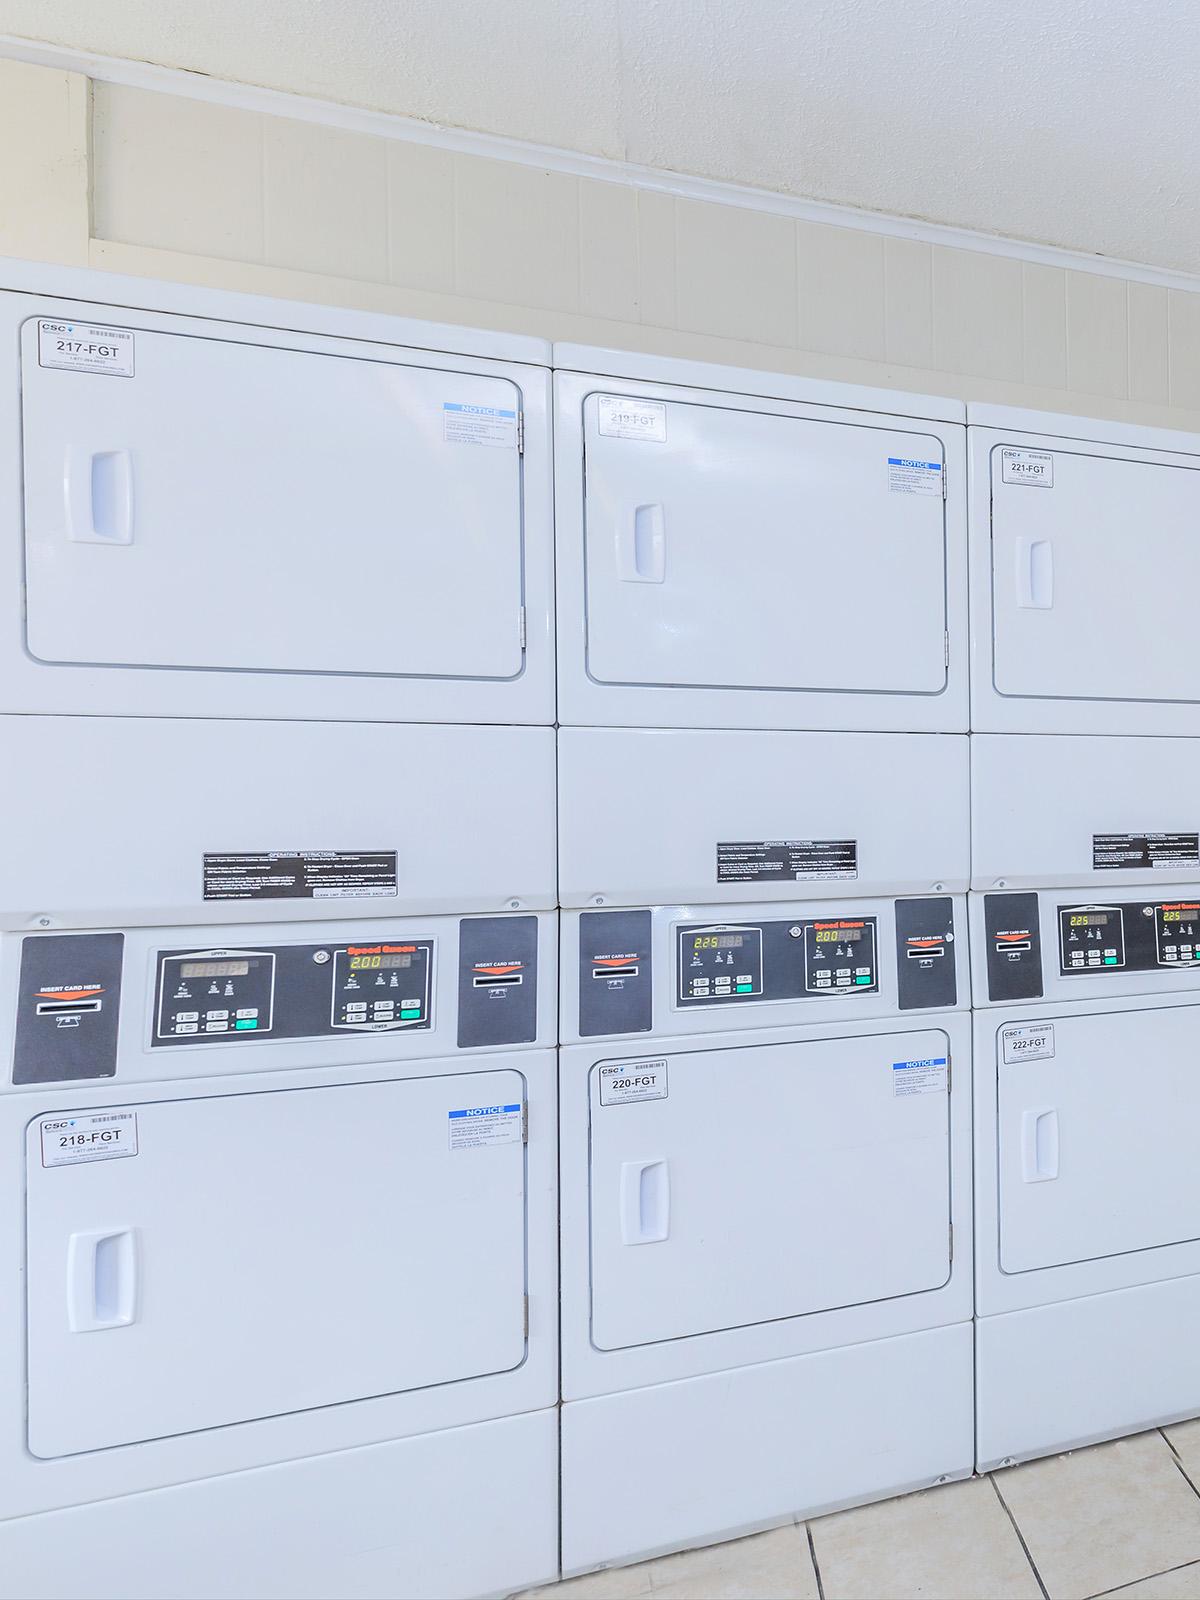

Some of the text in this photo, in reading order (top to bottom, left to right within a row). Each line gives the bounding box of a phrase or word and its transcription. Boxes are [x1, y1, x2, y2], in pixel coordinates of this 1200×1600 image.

[42, 323, 66, 332] CSC
[57, 340, 119, 357] 217-FGT
[461, 405, 500, 416] NOTICE
[611, 412, 655, 426] 219-FGT
[900, 459, 930, 469] NOTICE
[1011, 463, 1045, 474] 221-FGT
[814, 922, 839, 930] Speed
[347, 945, 417, 956] Speed Queen
[1012, 1038, 1046, 1049] 222-FGT
[905, 1060, 935, 1068] NOTICE
[602, 1067, 619, 1075] CSC
[612, 1075, 656, 1089] 220-FGT
[466, 1106, 505, 1117] NOTICE
[44, 1121, 69, 1130] CSC
[59, 1129, 122, 1147] 218-FGT
